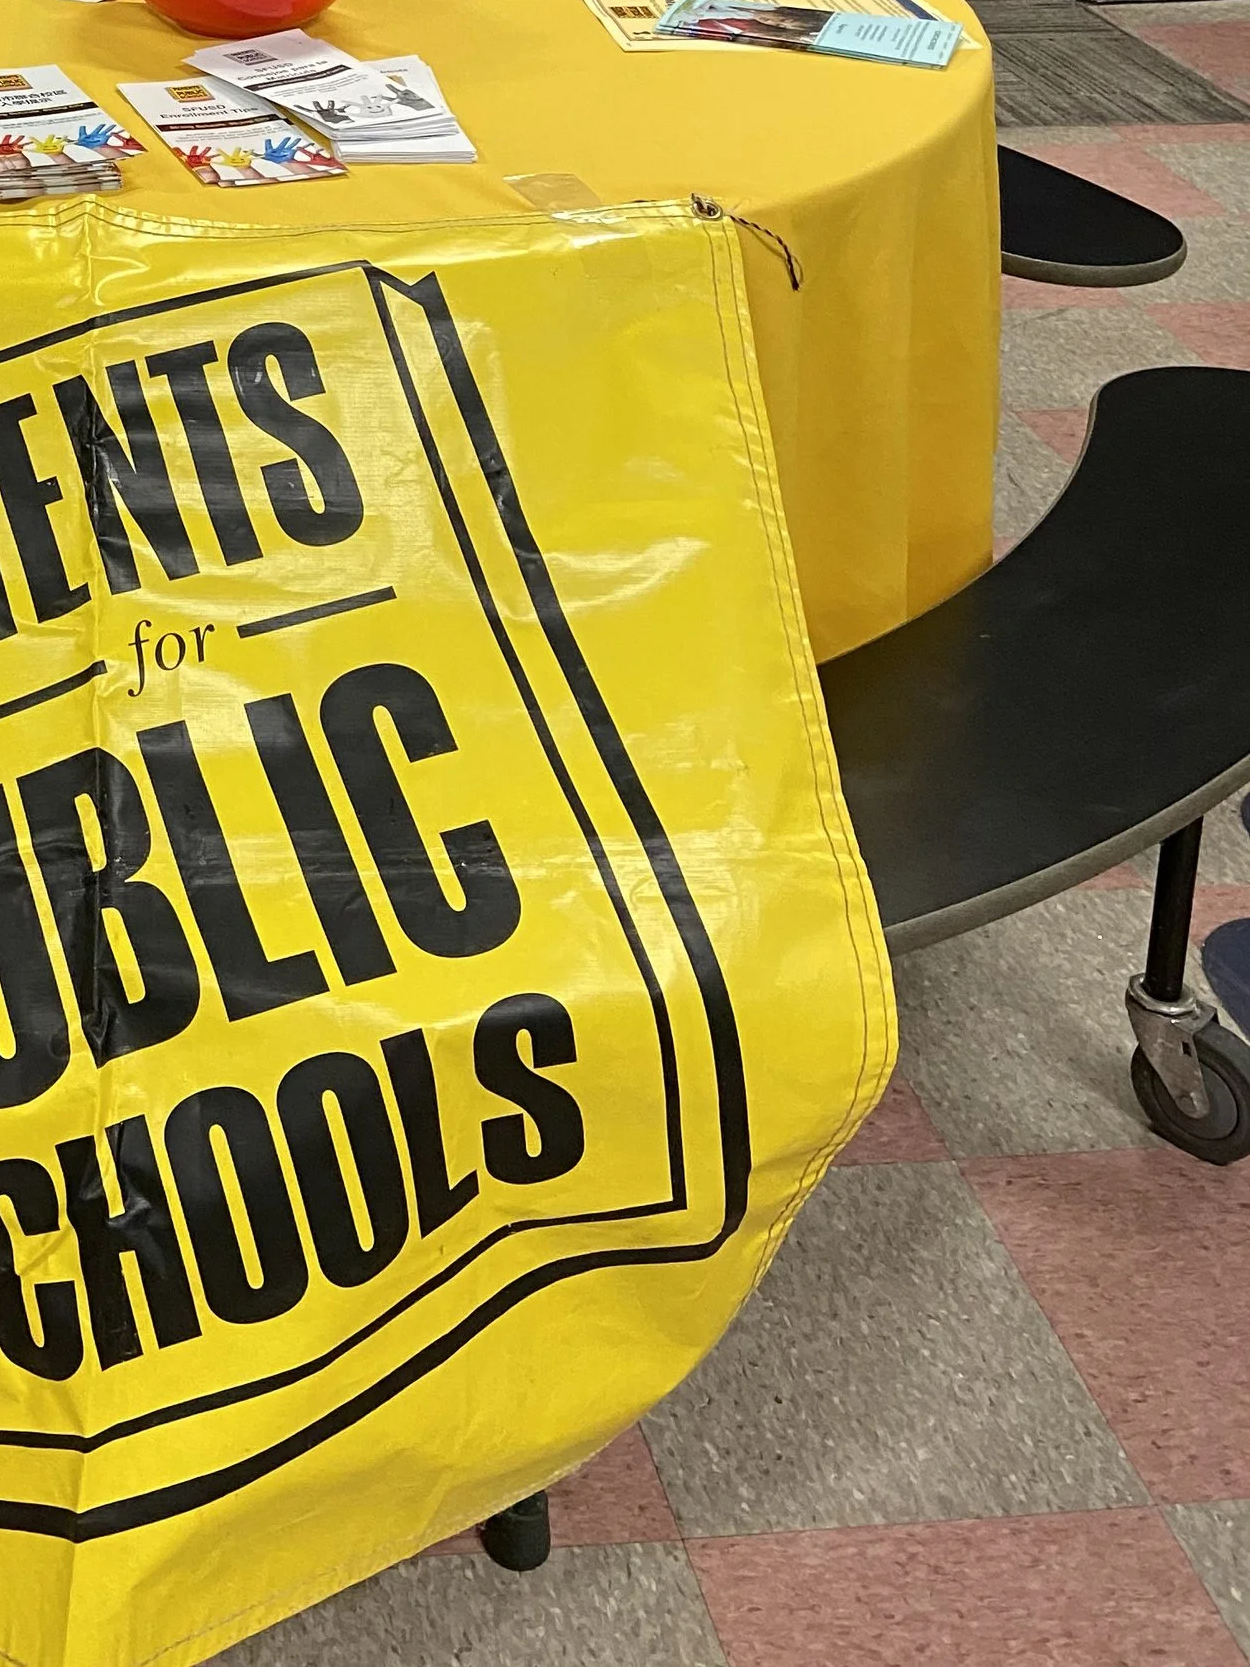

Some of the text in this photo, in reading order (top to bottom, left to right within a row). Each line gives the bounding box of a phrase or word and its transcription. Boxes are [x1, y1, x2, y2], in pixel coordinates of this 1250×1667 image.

[181, 104, 226, 112] SFUSD
[160, 110, 229, 119] Enrollment
[127, 619, 216, 697] for
